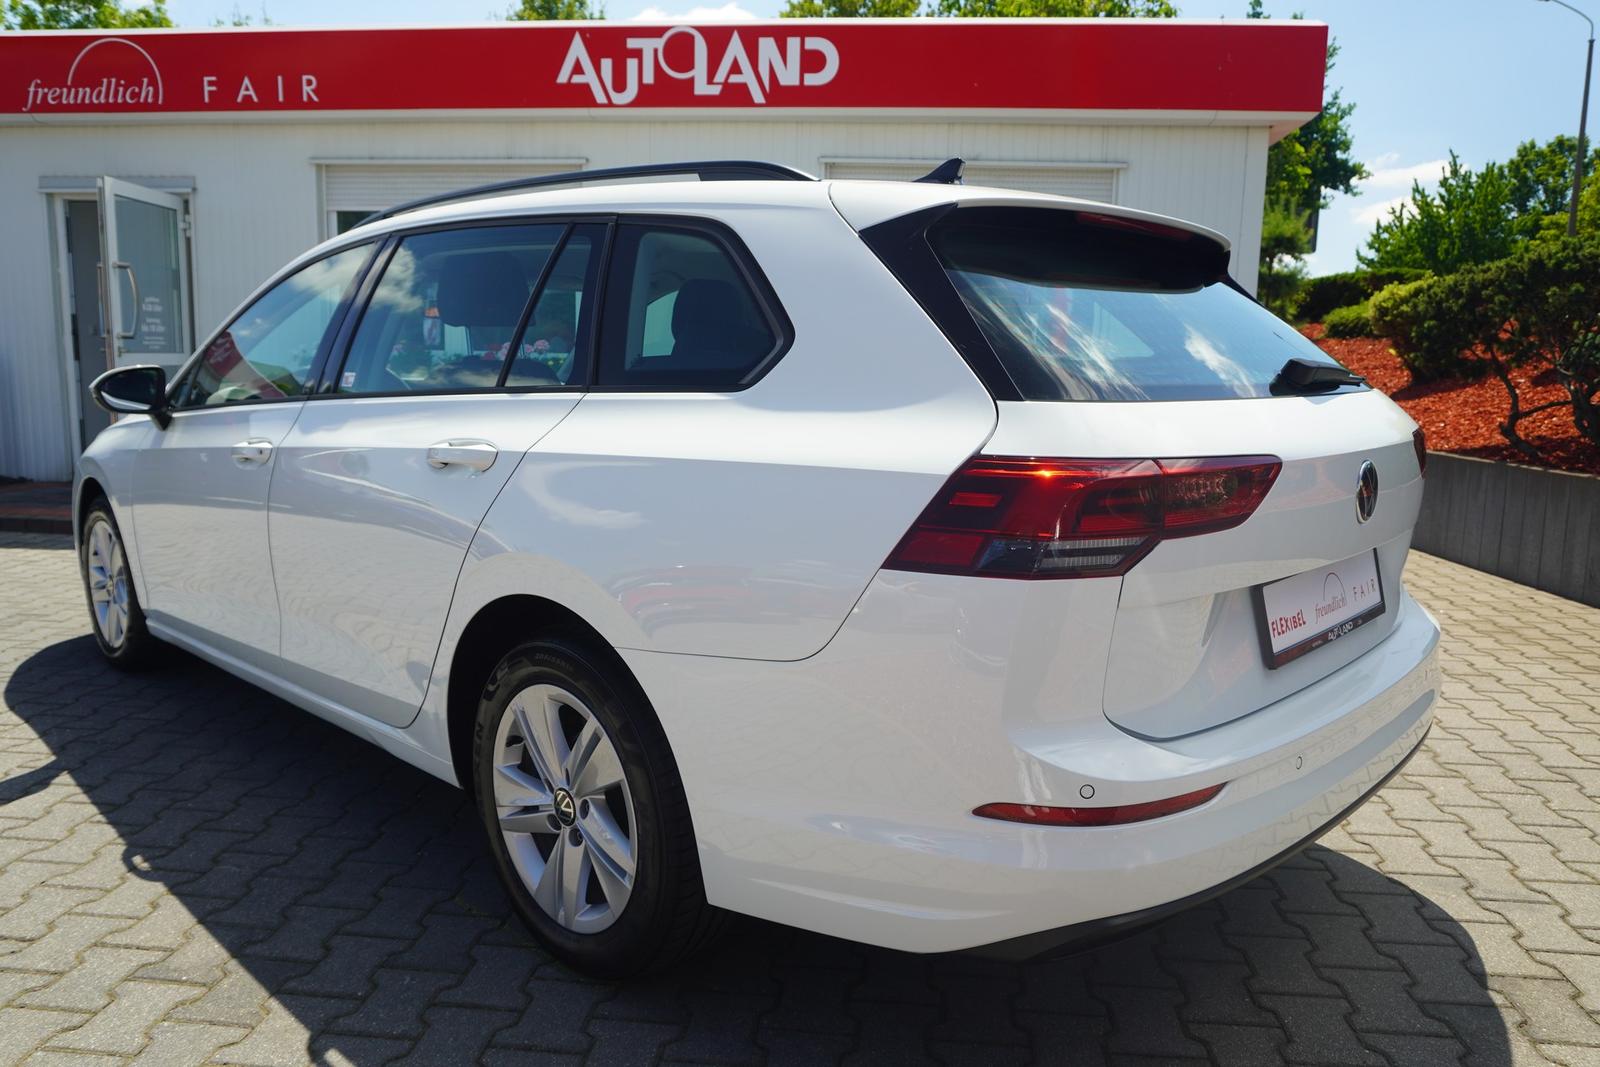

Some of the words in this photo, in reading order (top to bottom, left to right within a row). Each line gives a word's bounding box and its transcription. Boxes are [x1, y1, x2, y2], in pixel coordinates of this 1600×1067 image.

[22, 77, 155, 112] freundlich
[203, 74, 320, 104] FAIR
[1270, 609, 1307, 639] FLEXIBEL
[1314, 593, 1347, 625] freundlich
[1353, 578, 1376, 601] FAIR
